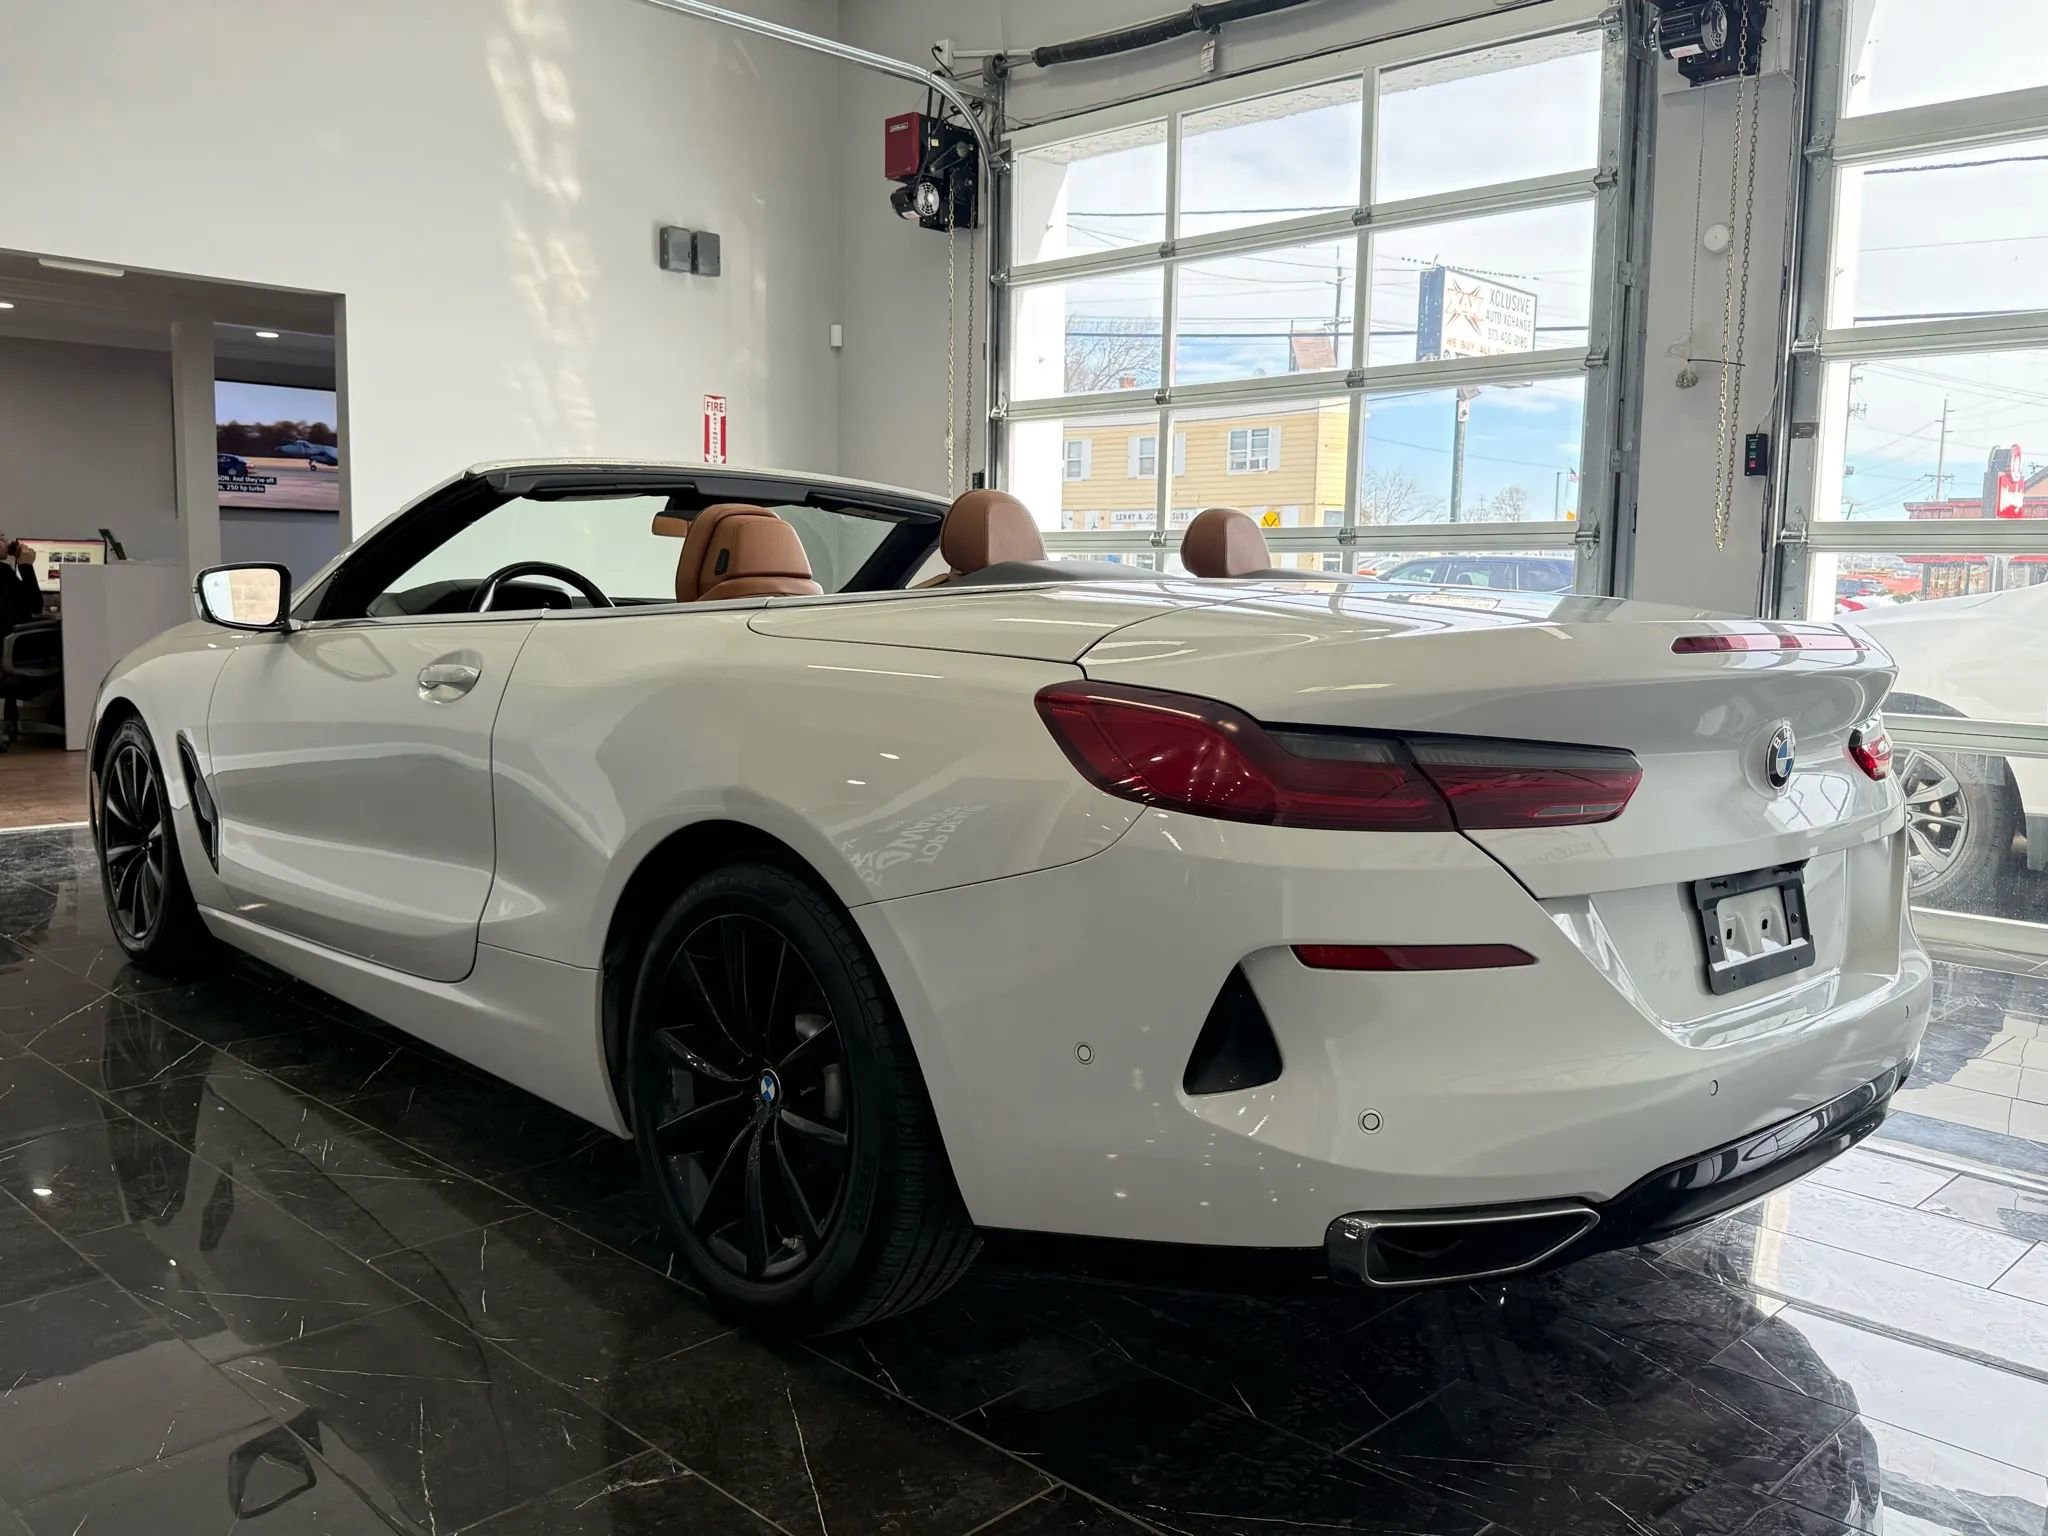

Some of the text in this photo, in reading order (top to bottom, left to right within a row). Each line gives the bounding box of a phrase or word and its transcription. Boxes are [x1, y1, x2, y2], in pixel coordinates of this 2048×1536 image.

[1488, 288, 1531, 315] XCLUSIVE
[1485, 309, 1532, 333] AUTO XCHANGE
[706, 401, 724, 413] FIRE
[245, 476, 265, 485] they're
[1116, 513, 1135, 521] LENNY
[1172, 512, 1189, 520] SUBS
